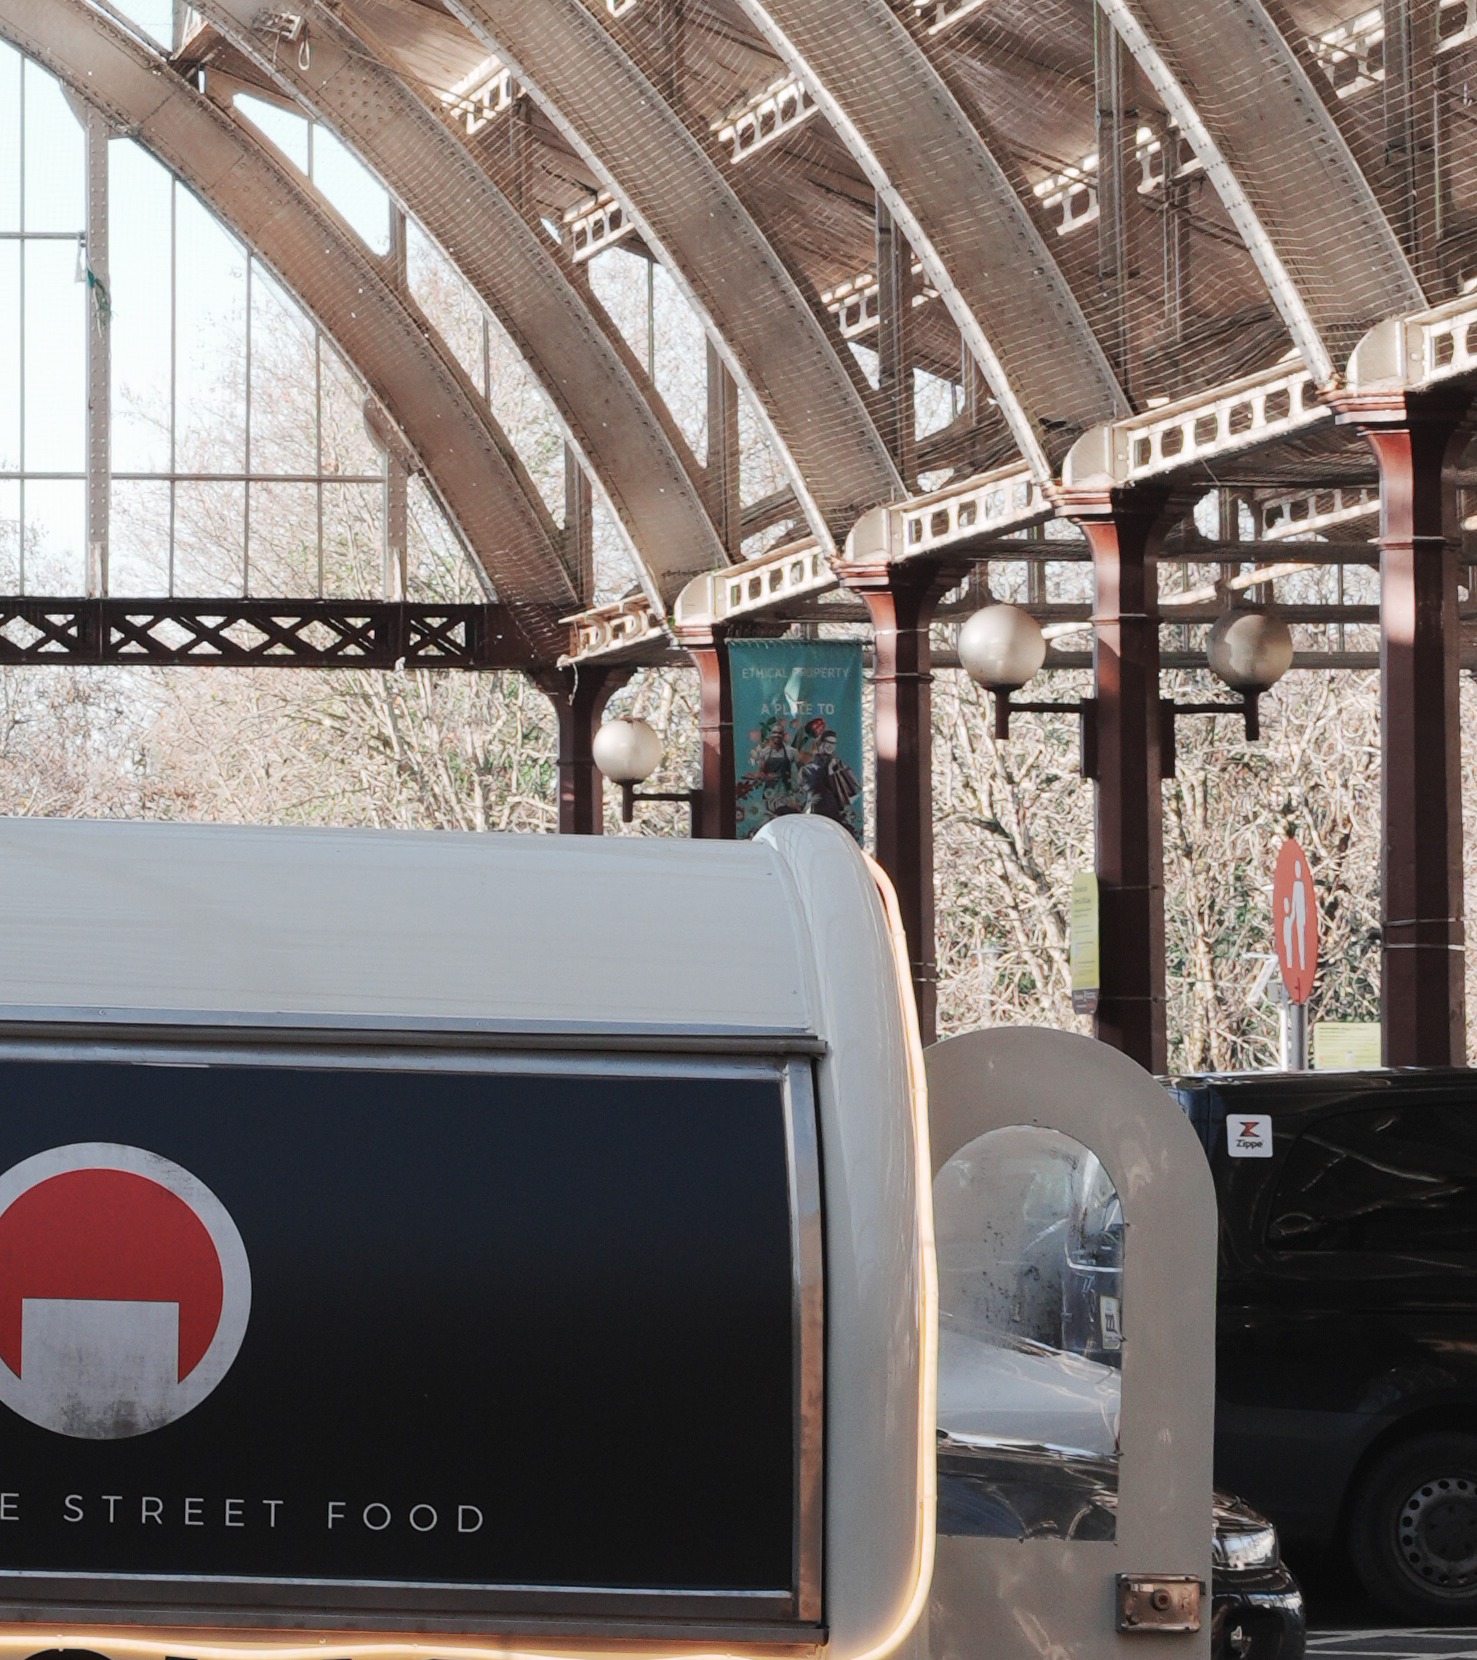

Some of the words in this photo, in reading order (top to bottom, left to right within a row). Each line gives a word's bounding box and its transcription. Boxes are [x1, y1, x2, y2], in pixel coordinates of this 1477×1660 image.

[742, 668, 787, 679] ETHICAL
[817, 703, 835, 715] TO
[64, 1495, 282, 1526] STREET
[328, 1502, 483, 1532] FOOD
